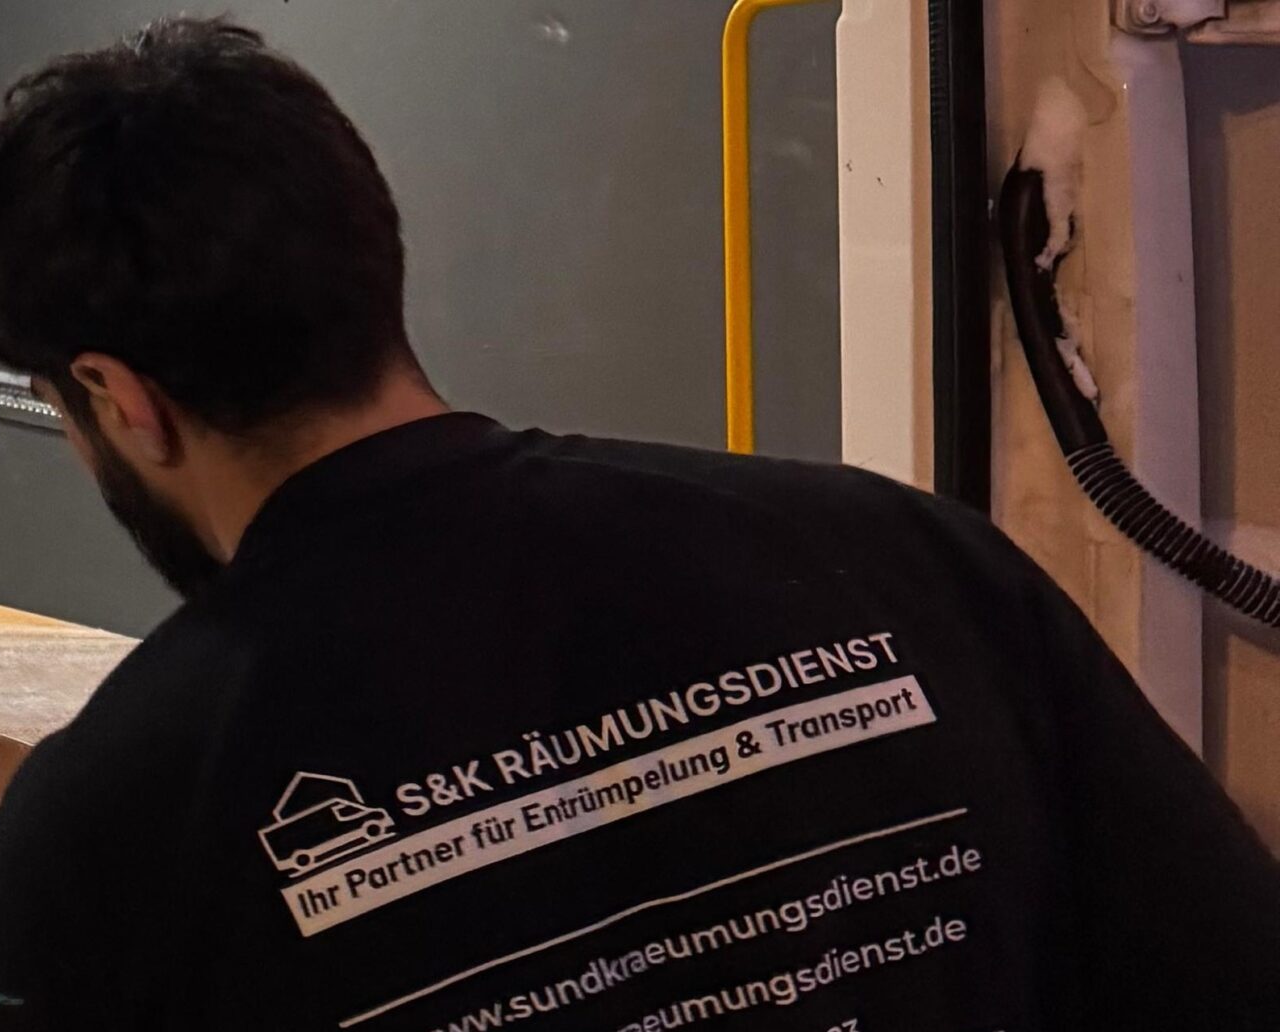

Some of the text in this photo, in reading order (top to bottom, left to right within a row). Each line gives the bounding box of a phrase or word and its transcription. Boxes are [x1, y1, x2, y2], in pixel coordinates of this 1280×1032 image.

[297, 688, 916, 918] Ihr Partner für Entrümpelung & Transport
[395, 633, 898, 816] S&K RÄUMUNGSDIENST
